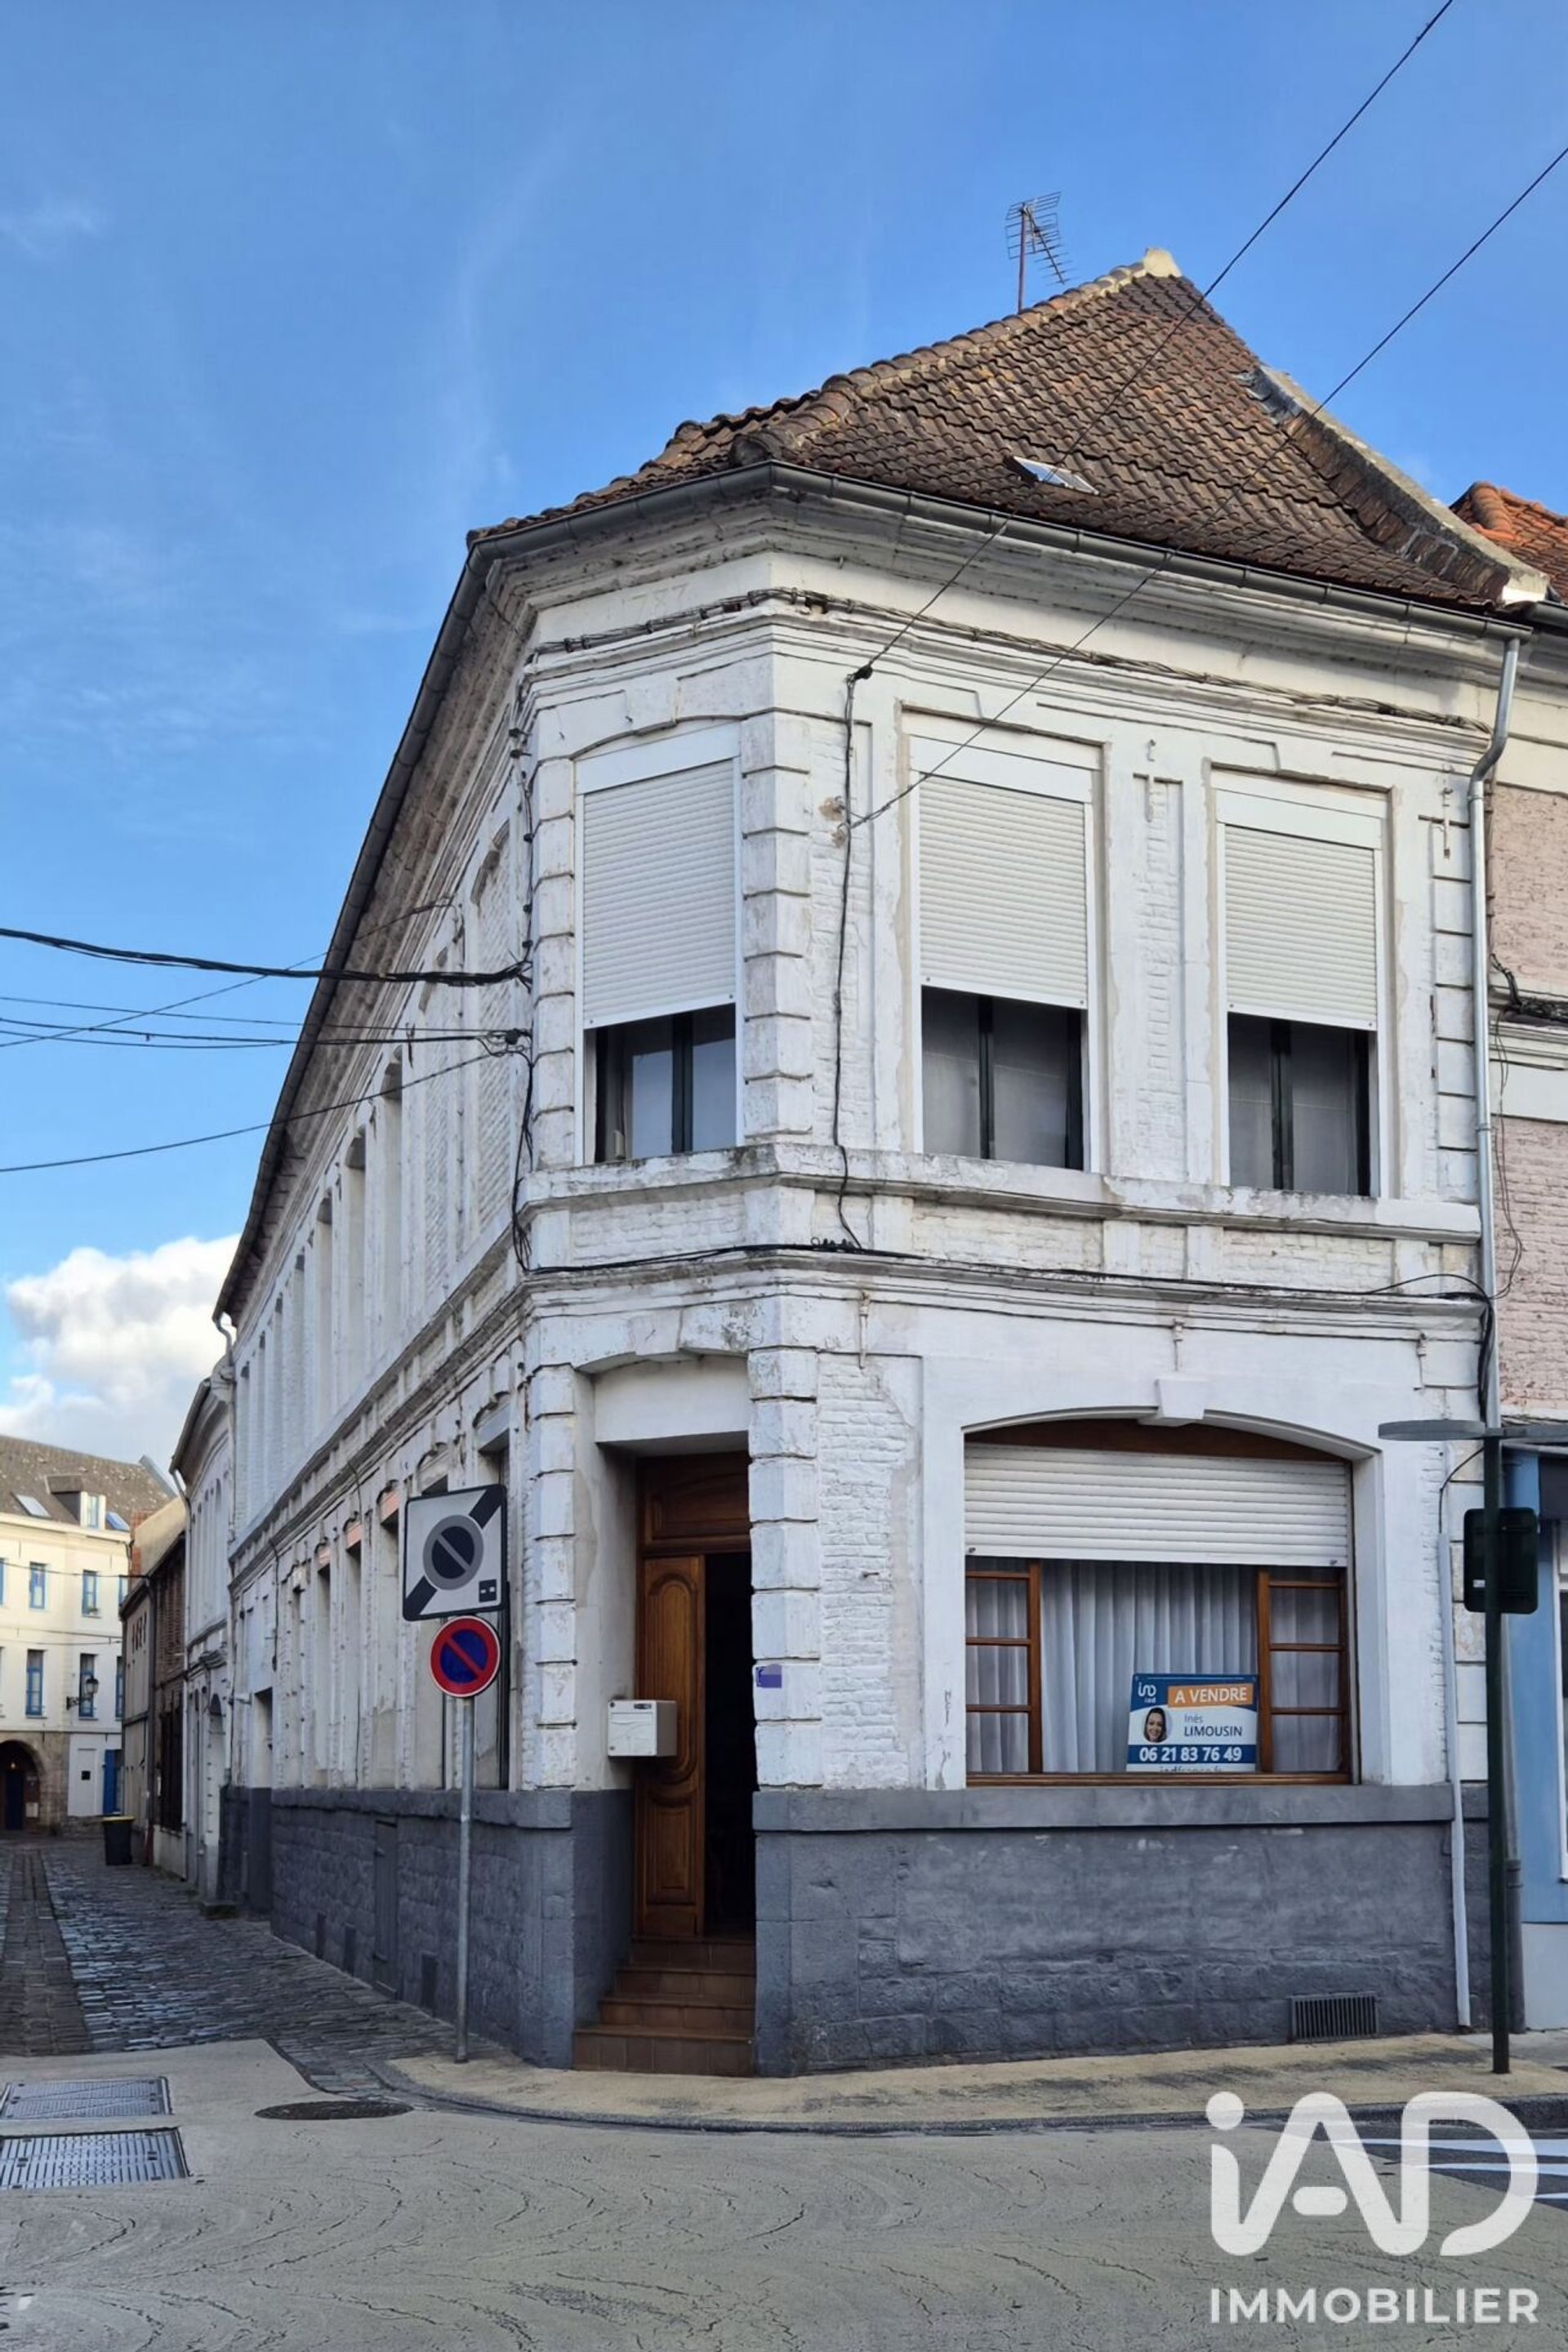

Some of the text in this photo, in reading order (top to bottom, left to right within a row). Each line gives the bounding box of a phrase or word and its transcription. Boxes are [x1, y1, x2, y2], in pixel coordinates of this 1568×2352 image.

[1174, 1687, 1248, 1704] A VENDRE
[1184, 1726, 1242, 1737] LIMOUSIN
[1139, 1747, 1242, 1762] 06 21 83 76 49
